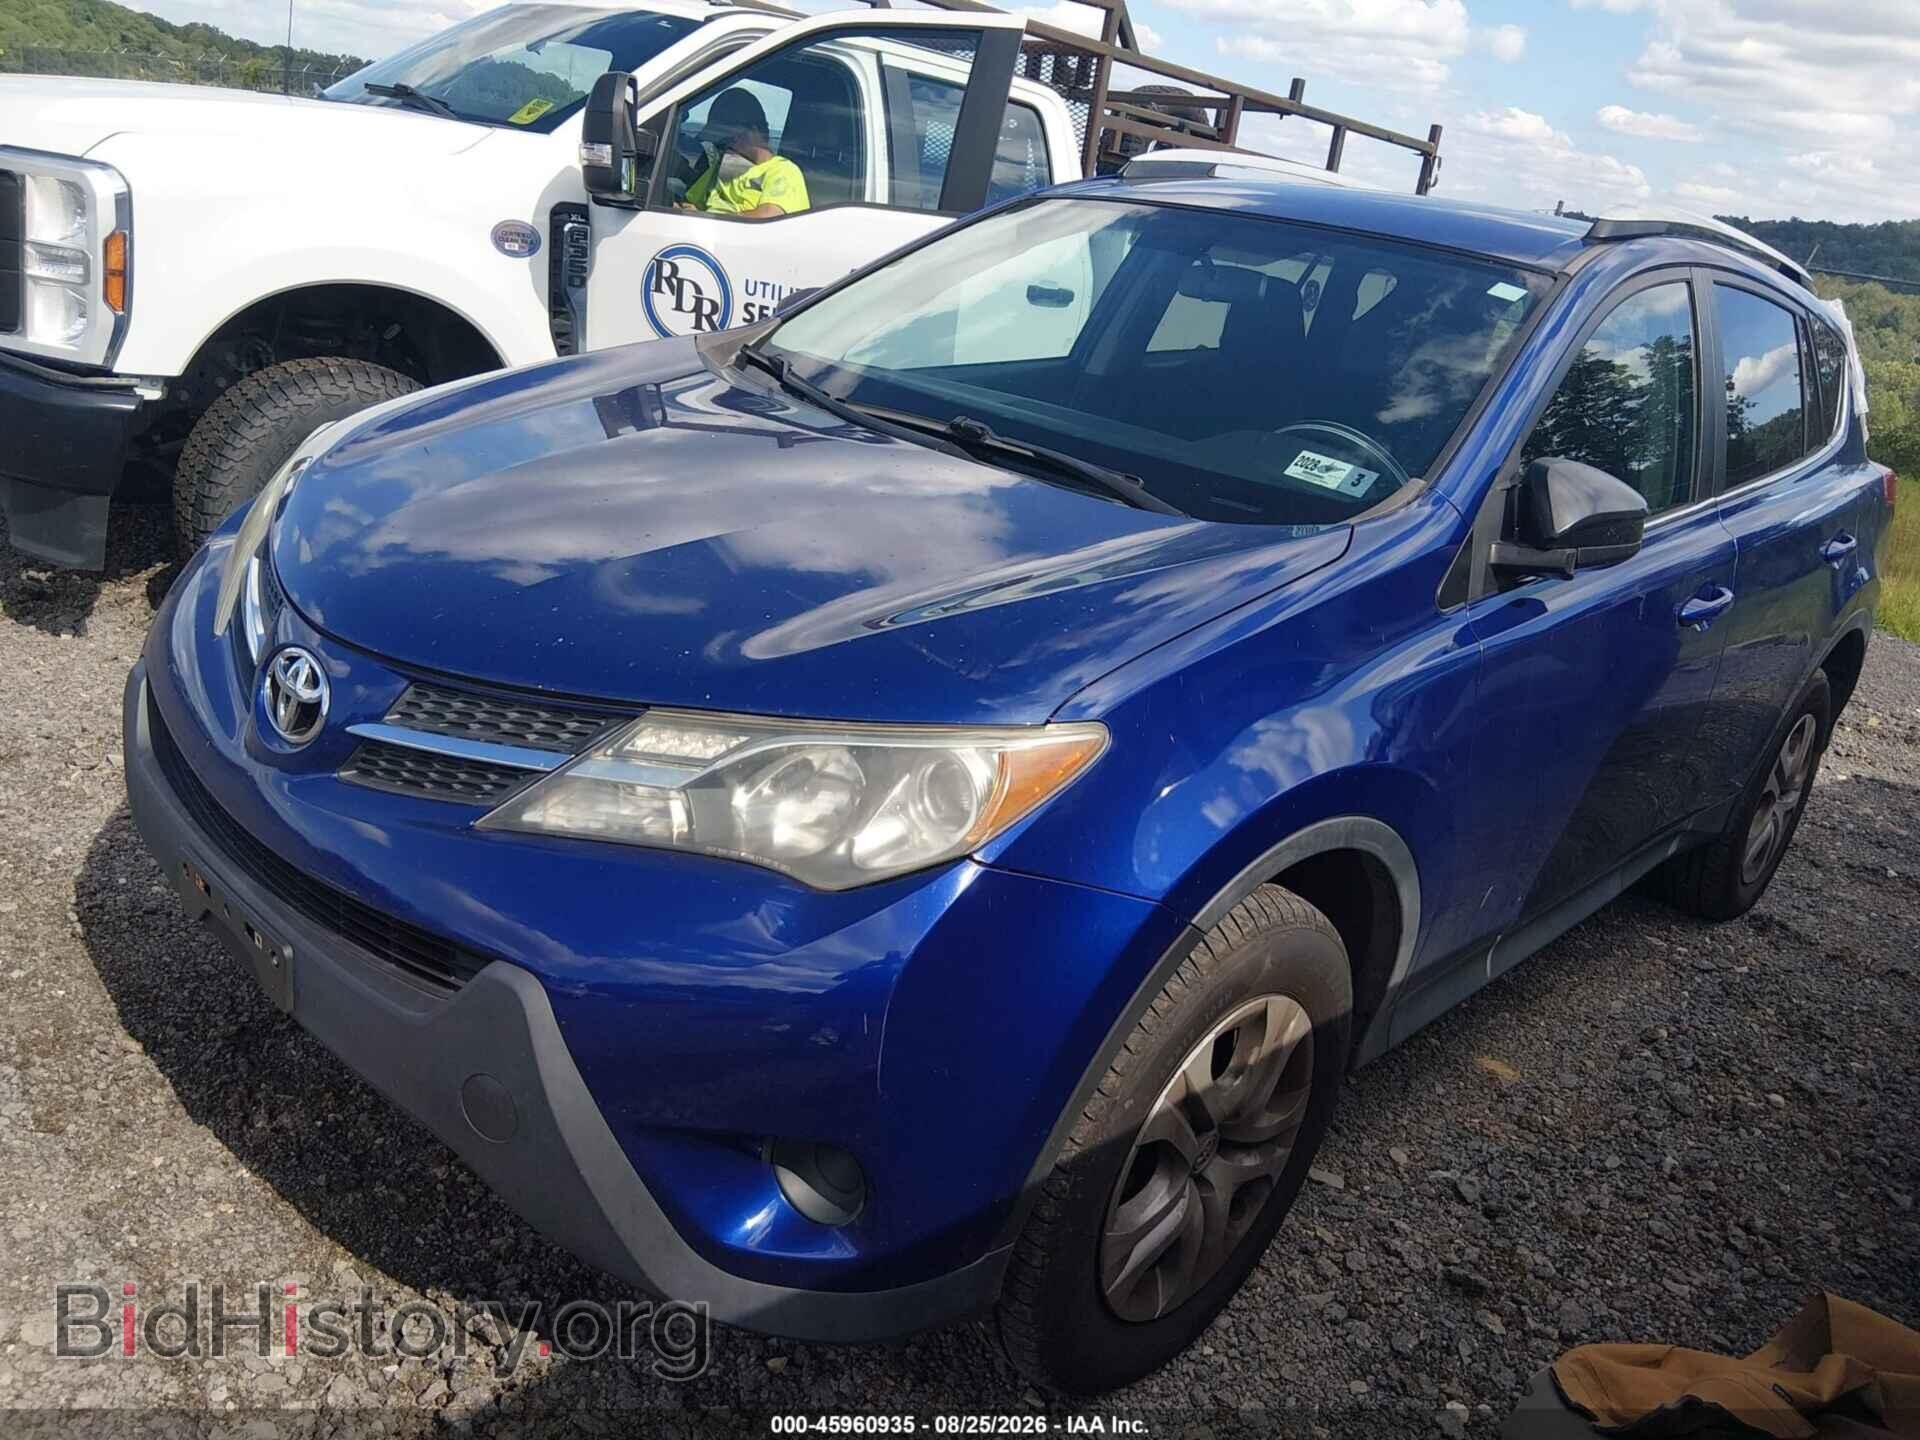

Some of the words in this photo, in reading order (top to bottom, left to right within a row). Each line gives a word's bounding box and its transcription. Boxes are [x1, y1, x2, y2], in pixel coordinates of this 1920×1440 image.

[570, 213, 586, 222] XL
[651, 258, 719, 332] RDR
[742, 302, 777, 323] SE
[1351, 473, 1366, 487] 3
